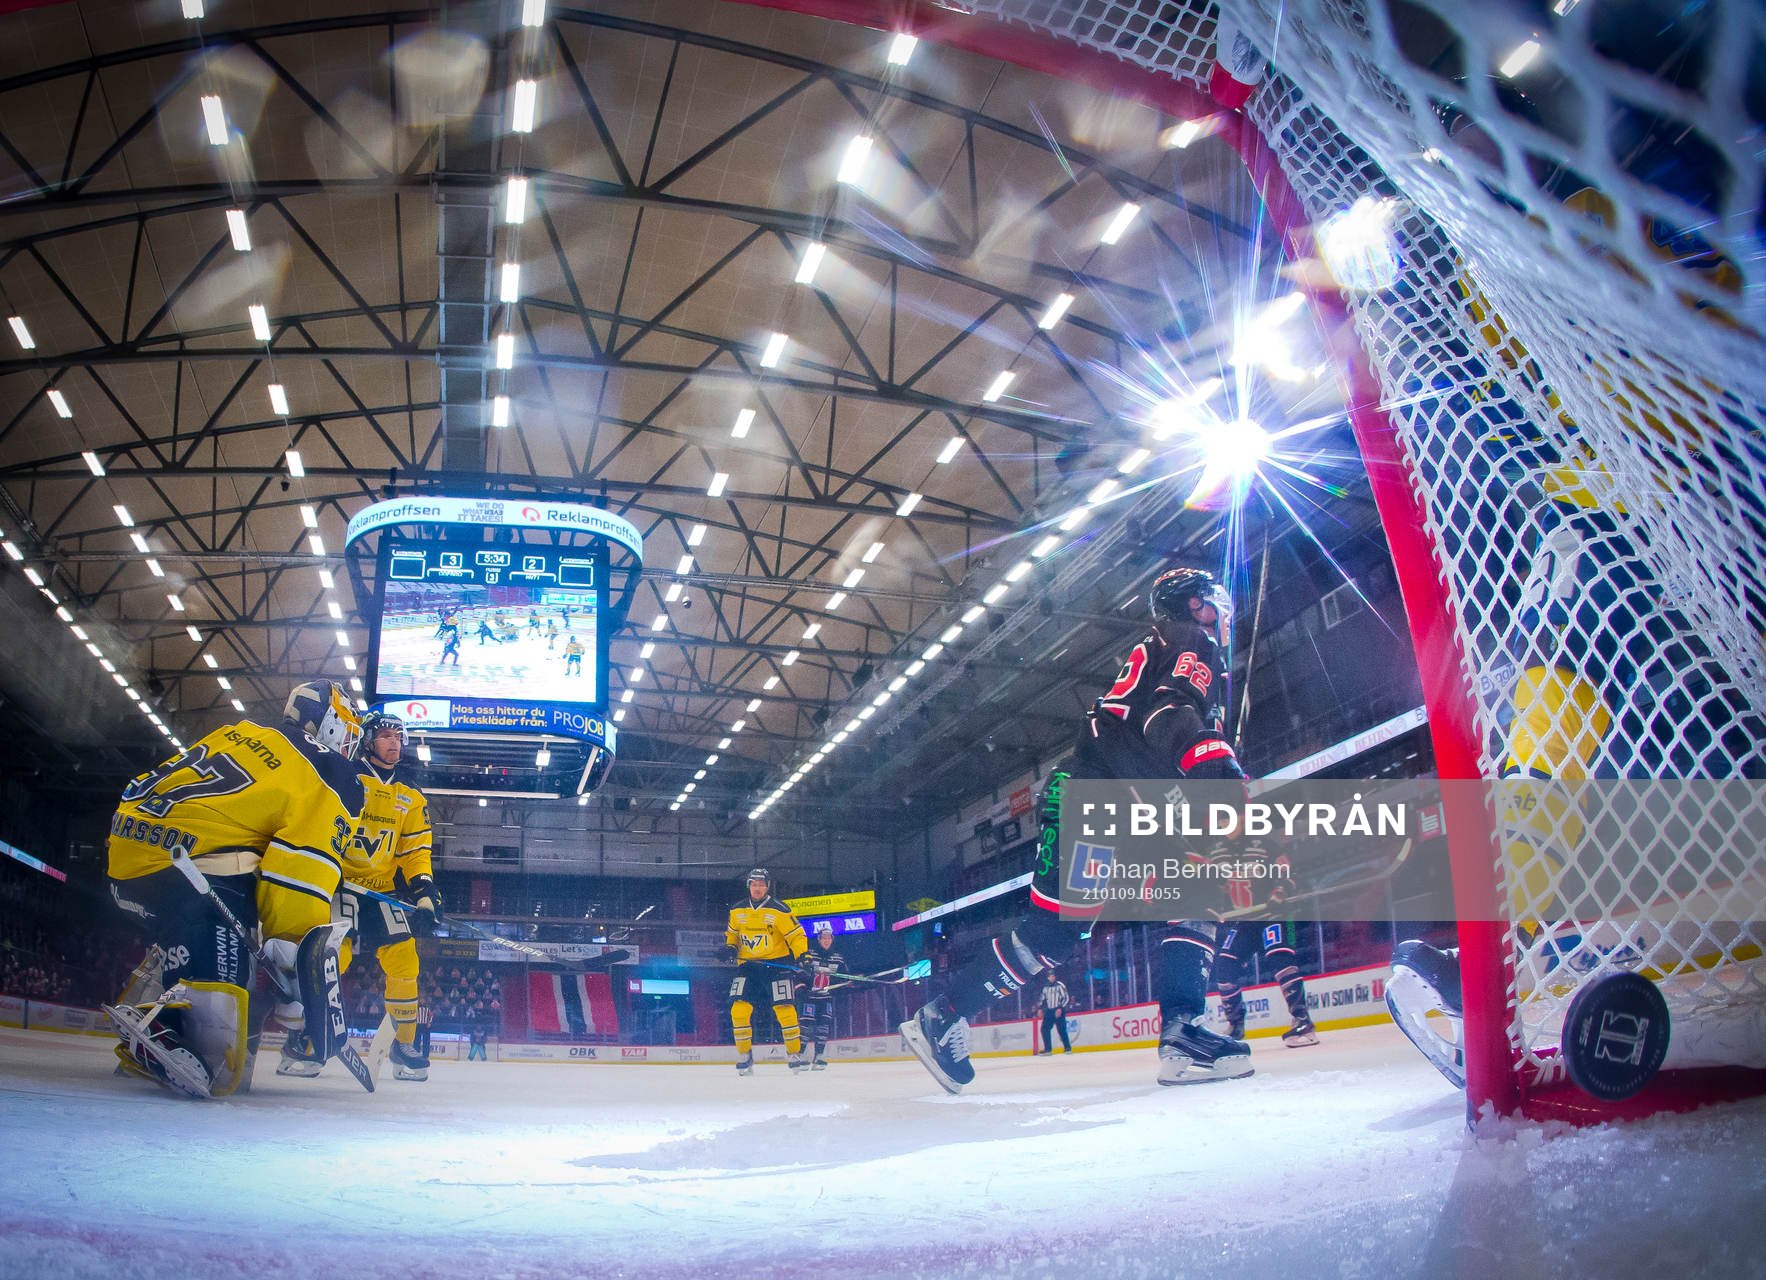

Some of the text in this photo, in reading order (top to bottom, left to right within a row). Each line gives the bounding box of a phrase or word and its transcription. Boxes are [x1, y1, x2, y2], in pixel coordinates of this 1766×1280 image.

[449, 555, 457, 565] 3
[483, 555, 505, 564] 5:34
[528, 559, 536, 570] 2
[1172, 651, 1213, 697] 62
[452, 704, 546, 717] Hos oss hittar du
[451, 715, 548, 728] yrkeskläder från:
[553, 711, 604, 737] PROJOB
[111, 812, 198, 854] ARSSON
[844, 917, 866, 931] NA
[216, 925, 228, 982] HERWIN
[493, 937, 545, 957] BAUER
[1332, 988, 1355, 1007] SOM
[1112, 1011, 1161, 1039] Scand
[569, 1047, 597, 1056] OBK
